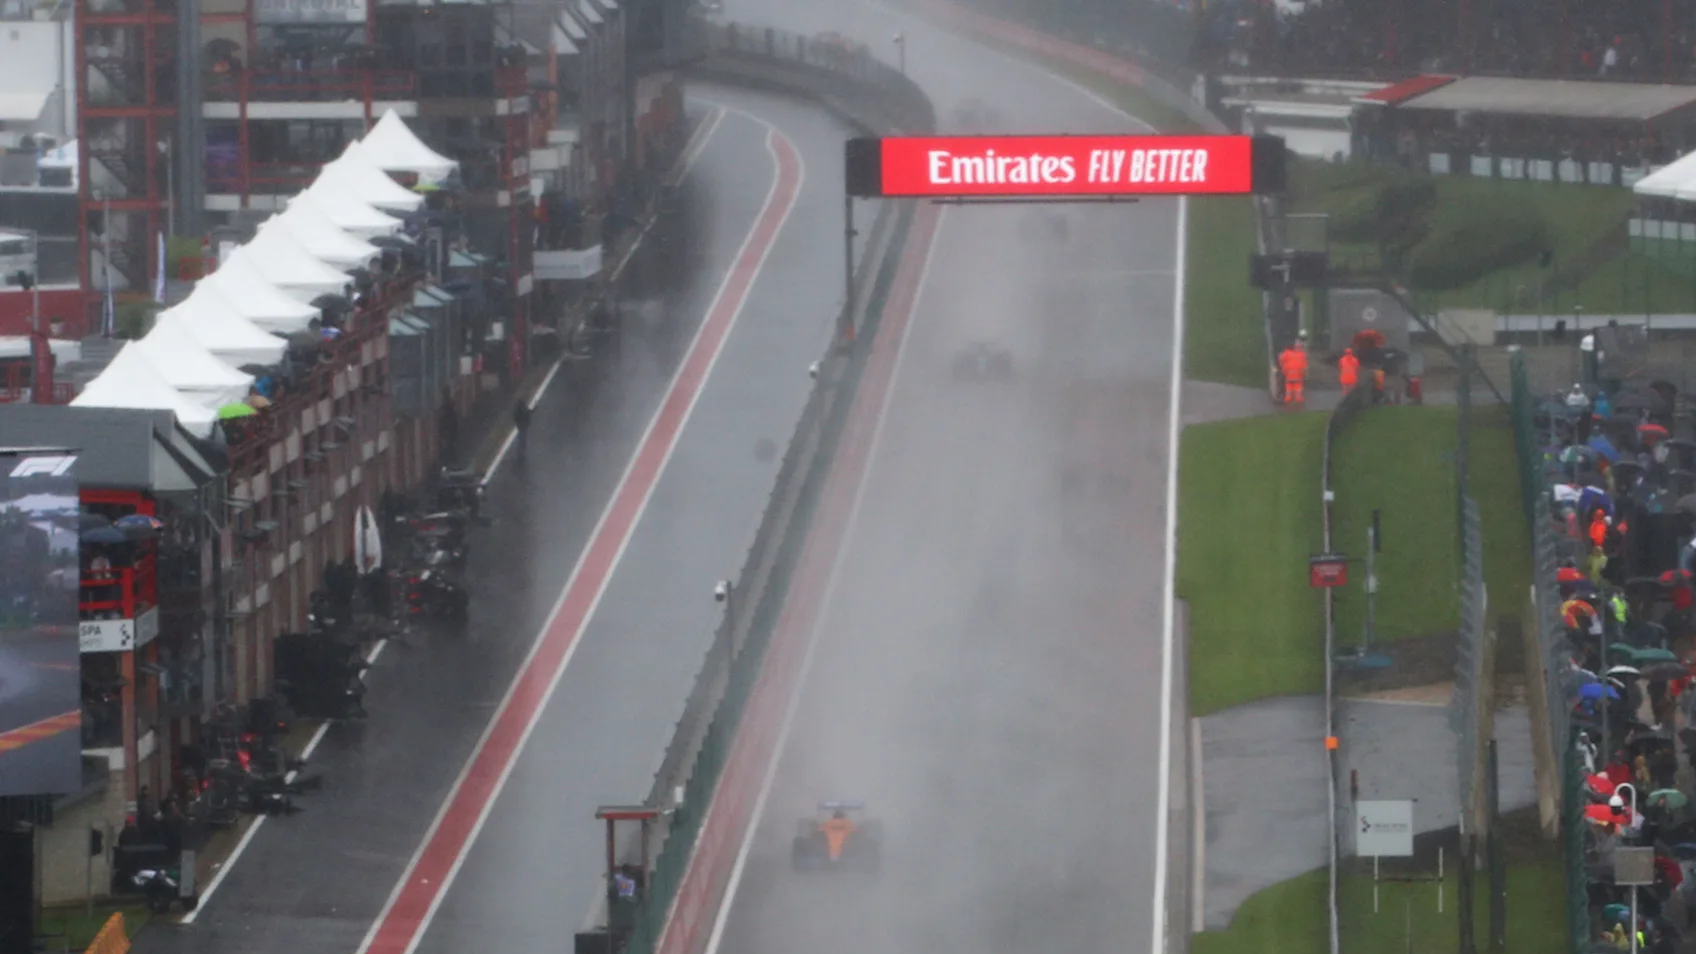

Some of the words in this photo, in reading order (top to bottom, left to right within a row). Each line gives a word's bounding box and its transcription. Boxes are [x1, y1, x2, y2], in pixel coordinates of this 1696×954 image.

[929, 149, 1076, 184] Emirates
[1088, 149, 1126, 183] FLY
[1129, 149, 1208, 183] BETTER
[80, 625, 102, 637] SPA
